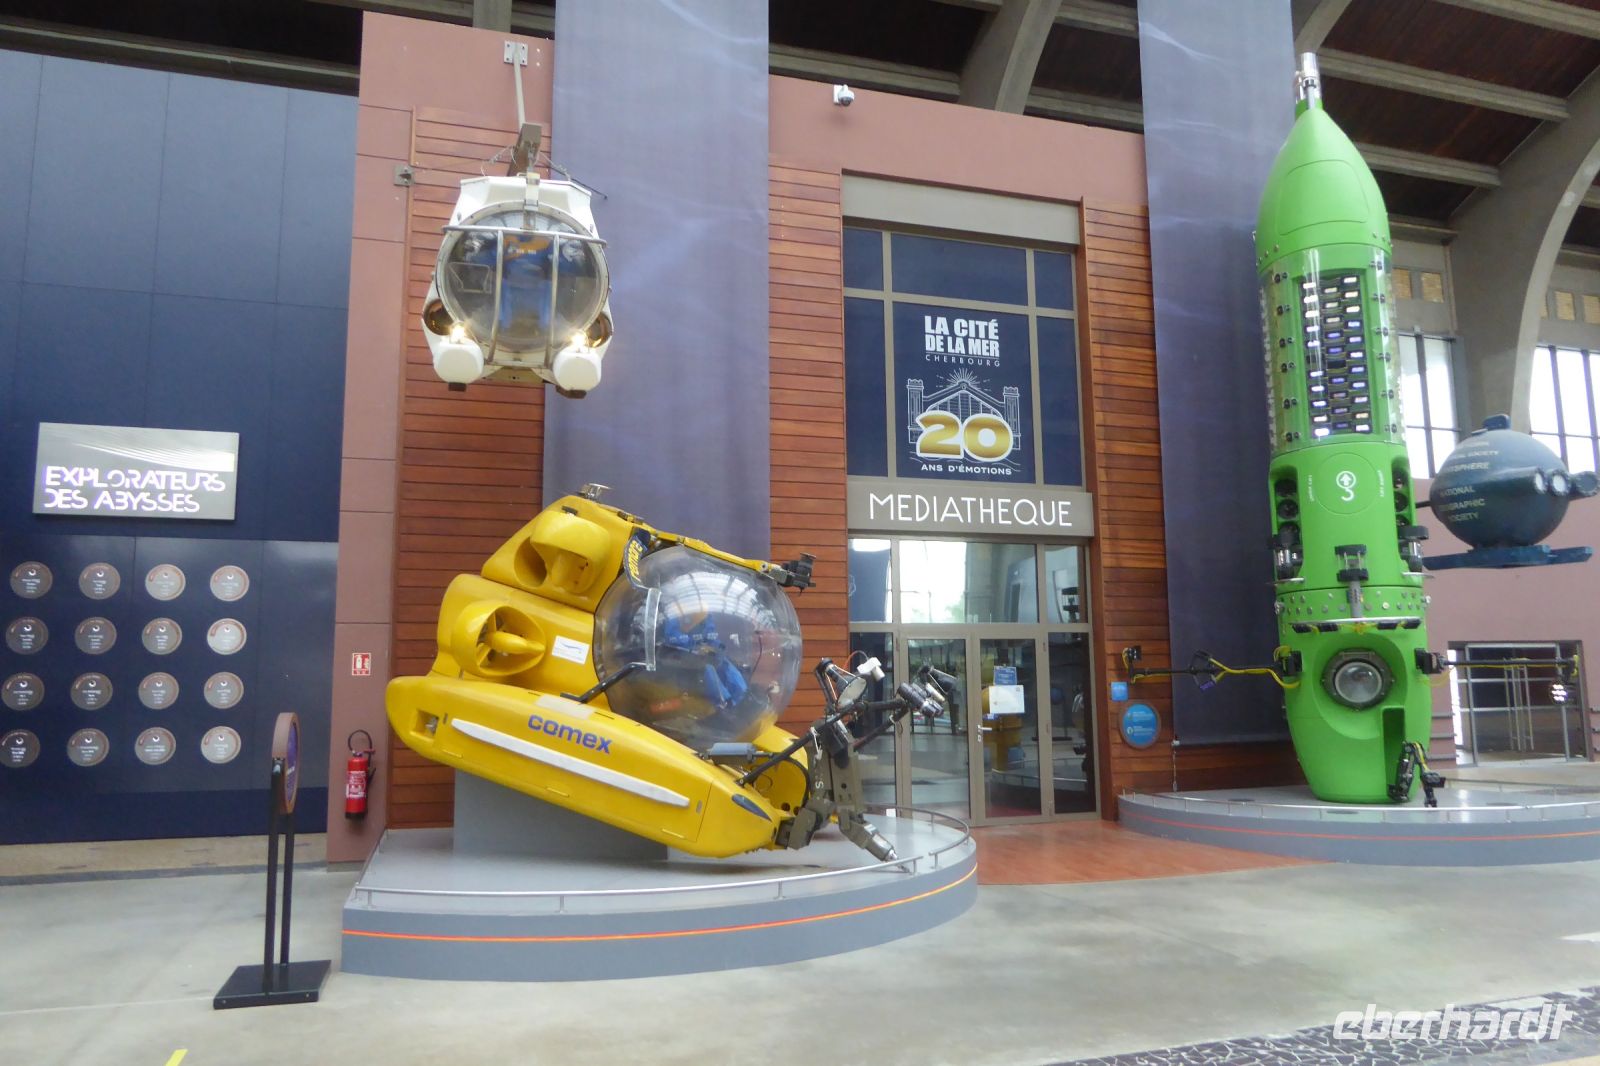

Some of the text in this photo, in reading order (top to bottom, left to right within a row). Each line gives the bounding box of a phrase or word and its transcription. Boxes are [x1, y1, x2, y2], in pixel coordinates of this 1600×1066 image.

[924, 315, 1000, 340] LA CITÉ
[925, 334, 1000, 358] DE LA MER
[925, 354, 1001, 367] CHERBOURG
[916, 410, 1014, 462] 20
[44, 465, 226, 493] EXPLORATEURS
[921, 463, 1012, 476] ANS D'ÉMOTIONS
[43, 488, 201, 514] DES ABYSSES
[869, 493, 1073, 527] MEDIATHEQUE
[527, 714, 613, 754] comex
